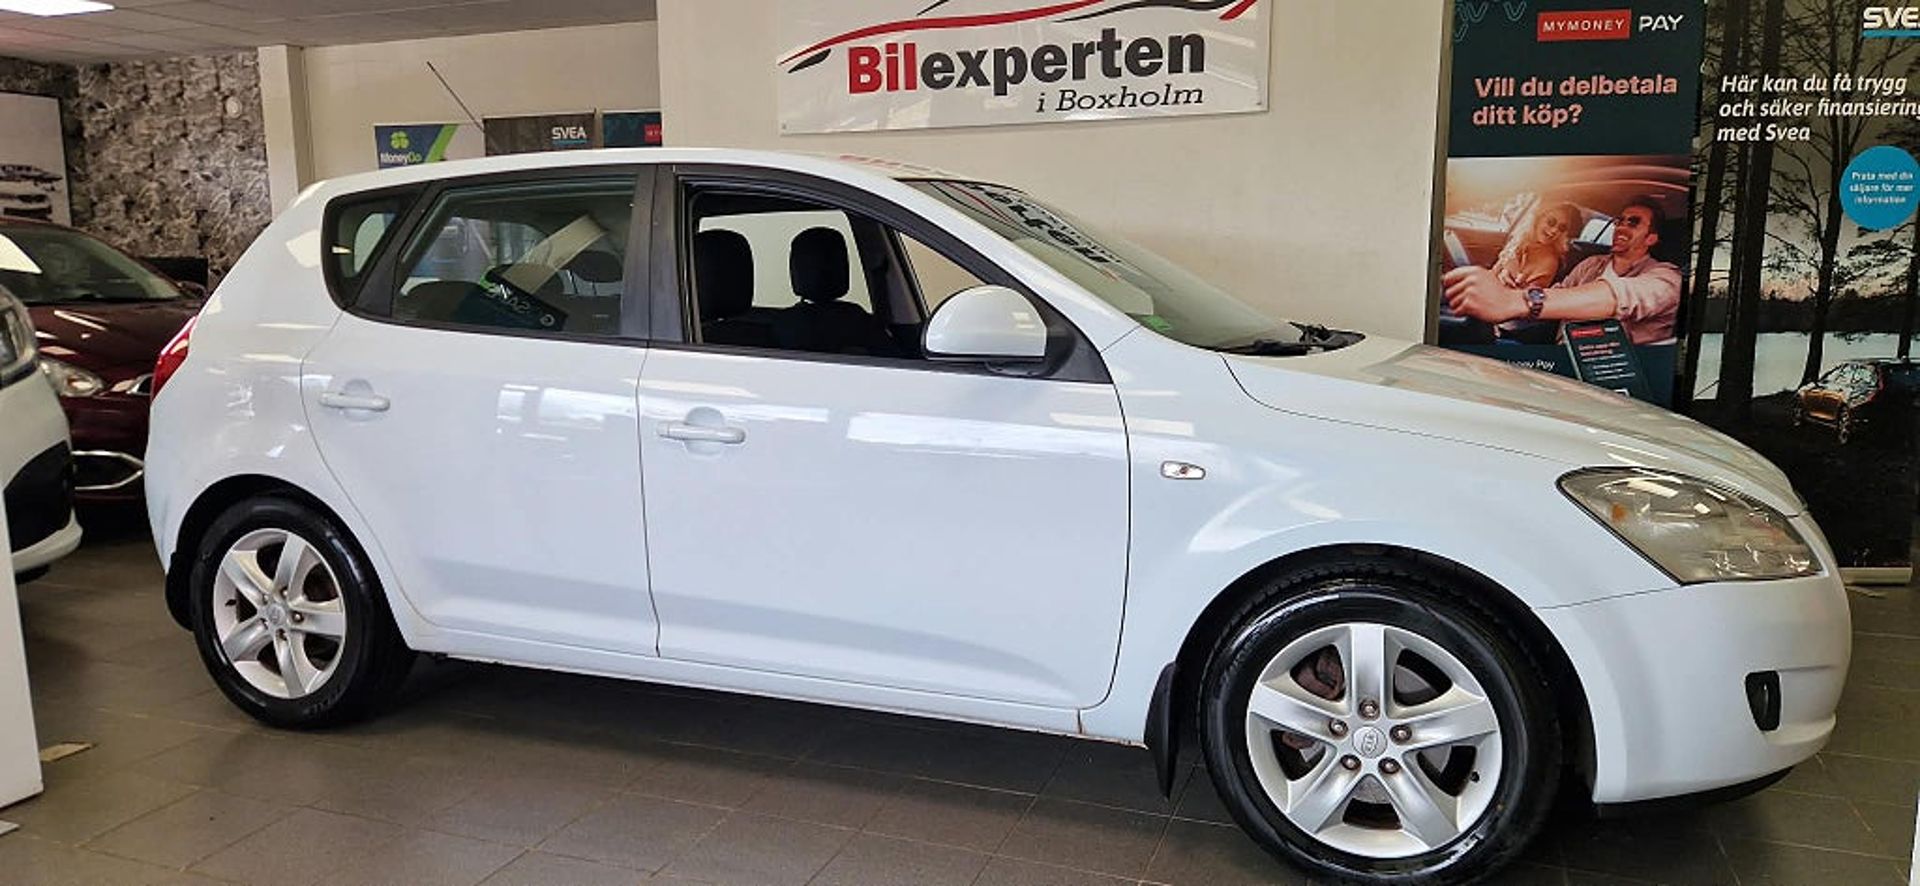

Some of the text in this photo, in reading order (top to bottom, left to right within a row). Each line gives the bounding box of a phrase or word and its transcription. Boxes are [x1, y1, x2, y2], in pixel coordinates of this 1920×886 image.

[1542, 14, 1684, 32] MYMONEY PAY
[1863, 7, 1920, 29] SVE
[848, 27, 1206, 96] Bilexperten
[1474, 73, 1678, 97] Vill du delbetala
[1721, 73, 1908, 96] Här kan du få trygg
[1036, 84, 1204, 113] i Boxholm
[1719, 99, 1755, 117] och
[1760, 98, 1813, 117] säker
[1472, 104, 1583, 128] ditt köp?
[552, 126, 588, 140] SVEA
[1717, 123, 1811, 142] med Svea
[380, 151, 423, 166] MoneyGo
